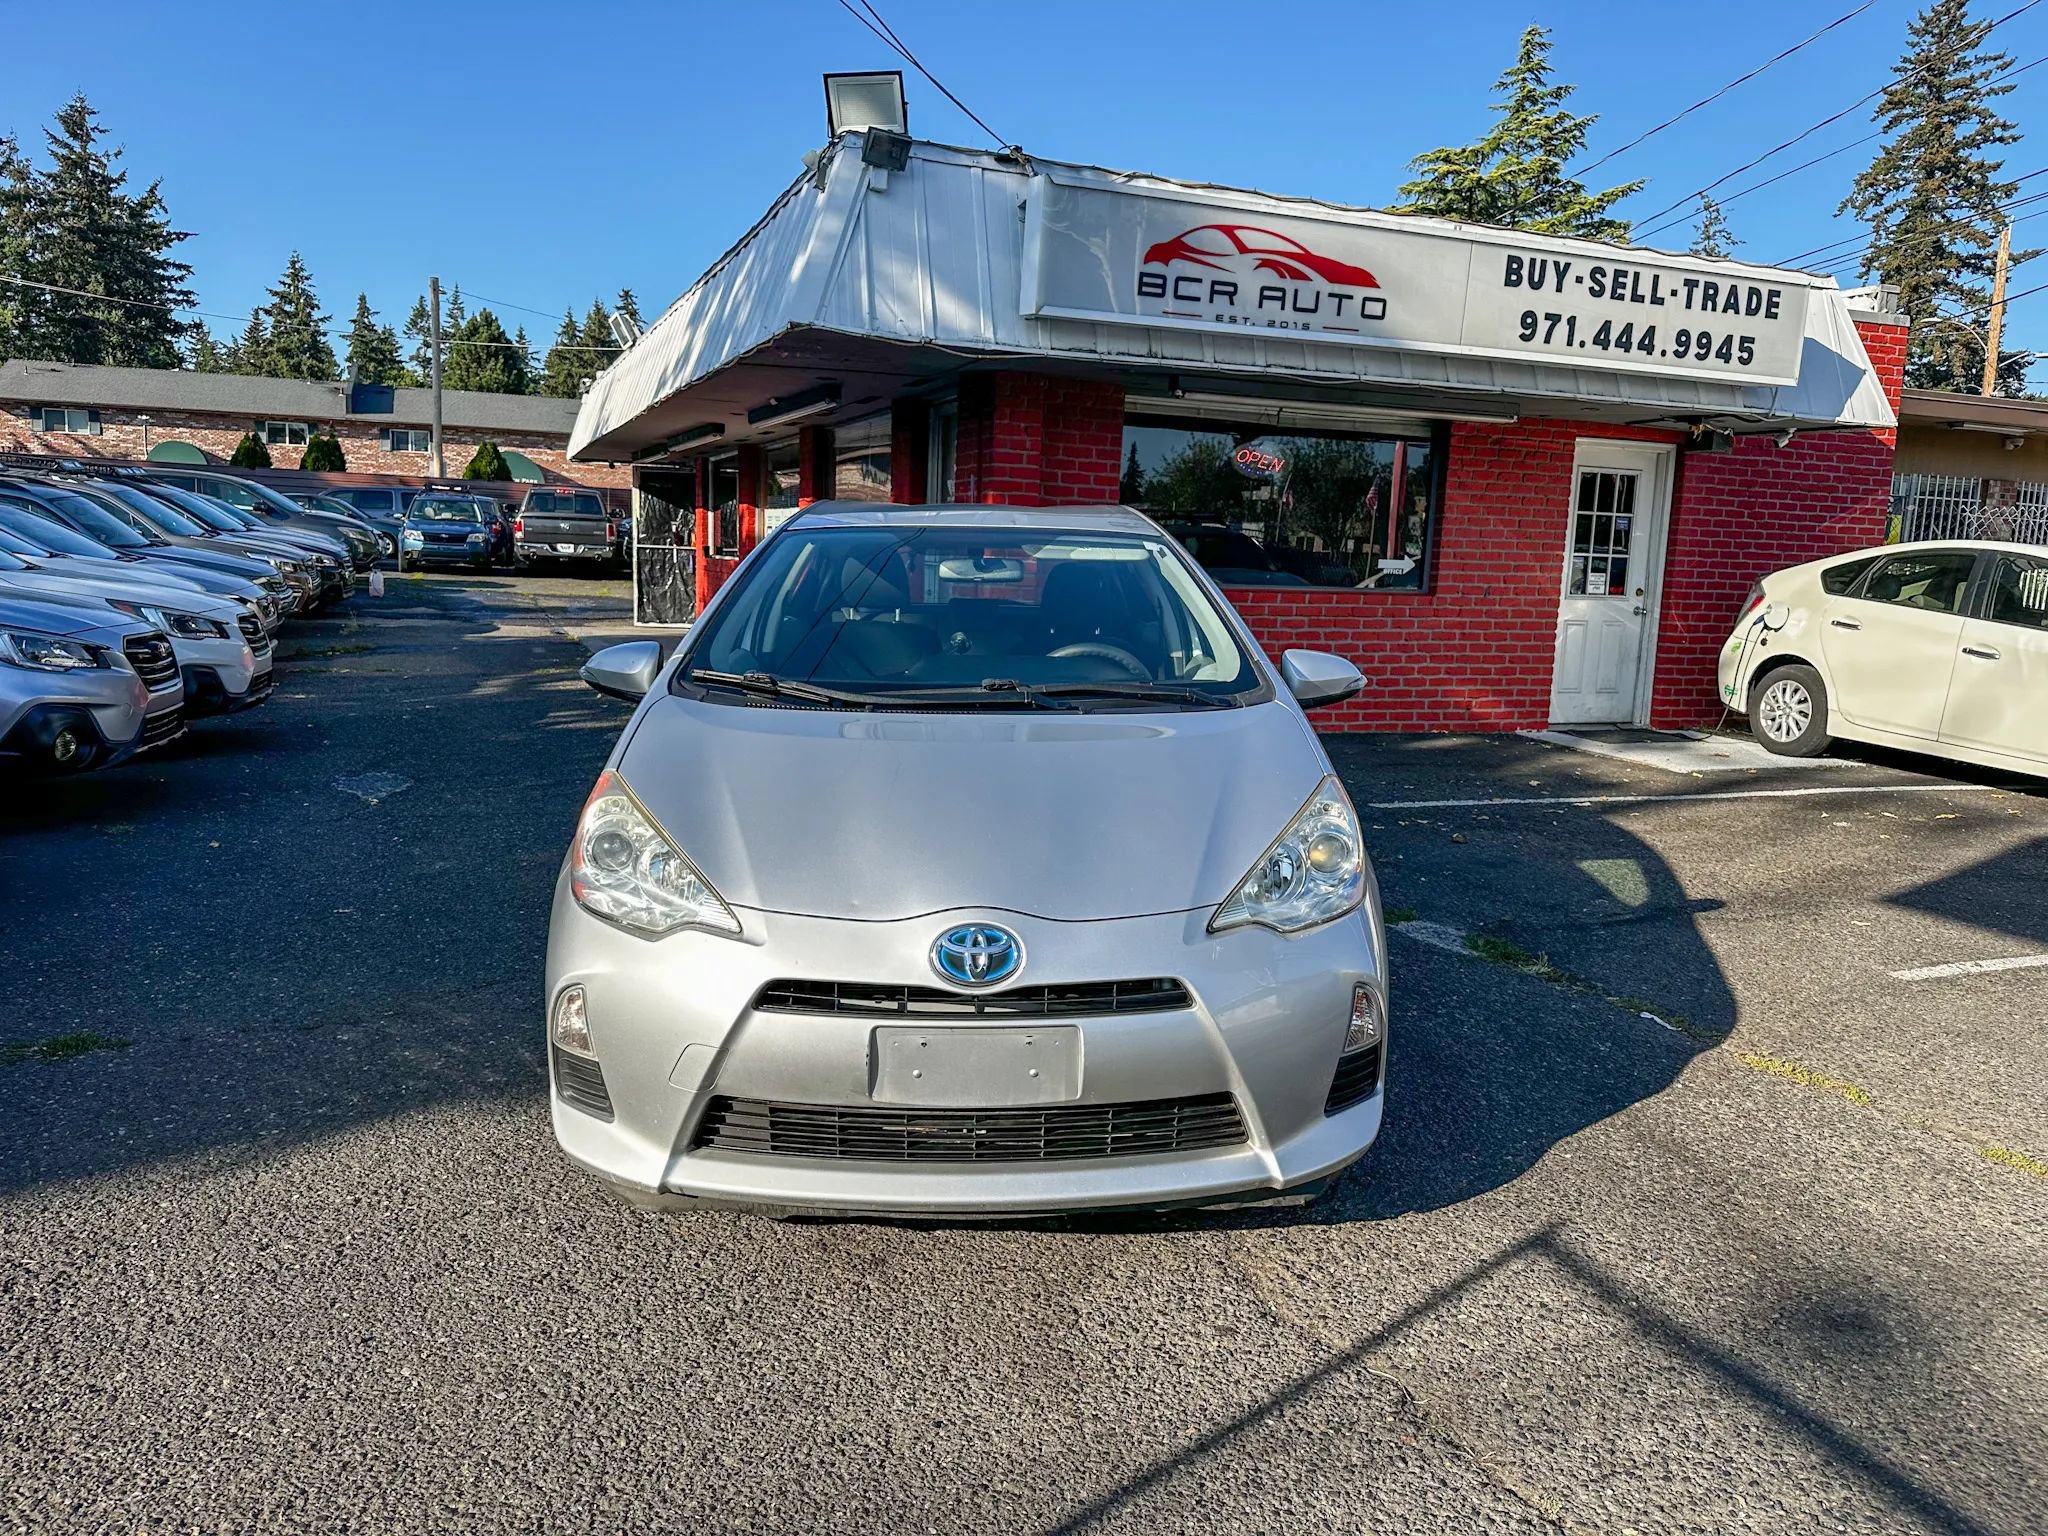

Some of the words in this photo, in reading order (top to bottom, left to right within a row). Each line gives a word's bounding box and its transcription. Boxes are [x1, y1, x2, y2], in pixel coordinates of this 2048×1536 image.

[1137, 271, 1238, 306] BCR
[1258, 284, 1387, 321] AUTO
[1215, 314, 1255, 326] EST.
[1267, 319, 1311, 331] 2015
[1518, 309, 1756, 366] 971.444.9945
[1236, 449, 1285, 473] OPEN
